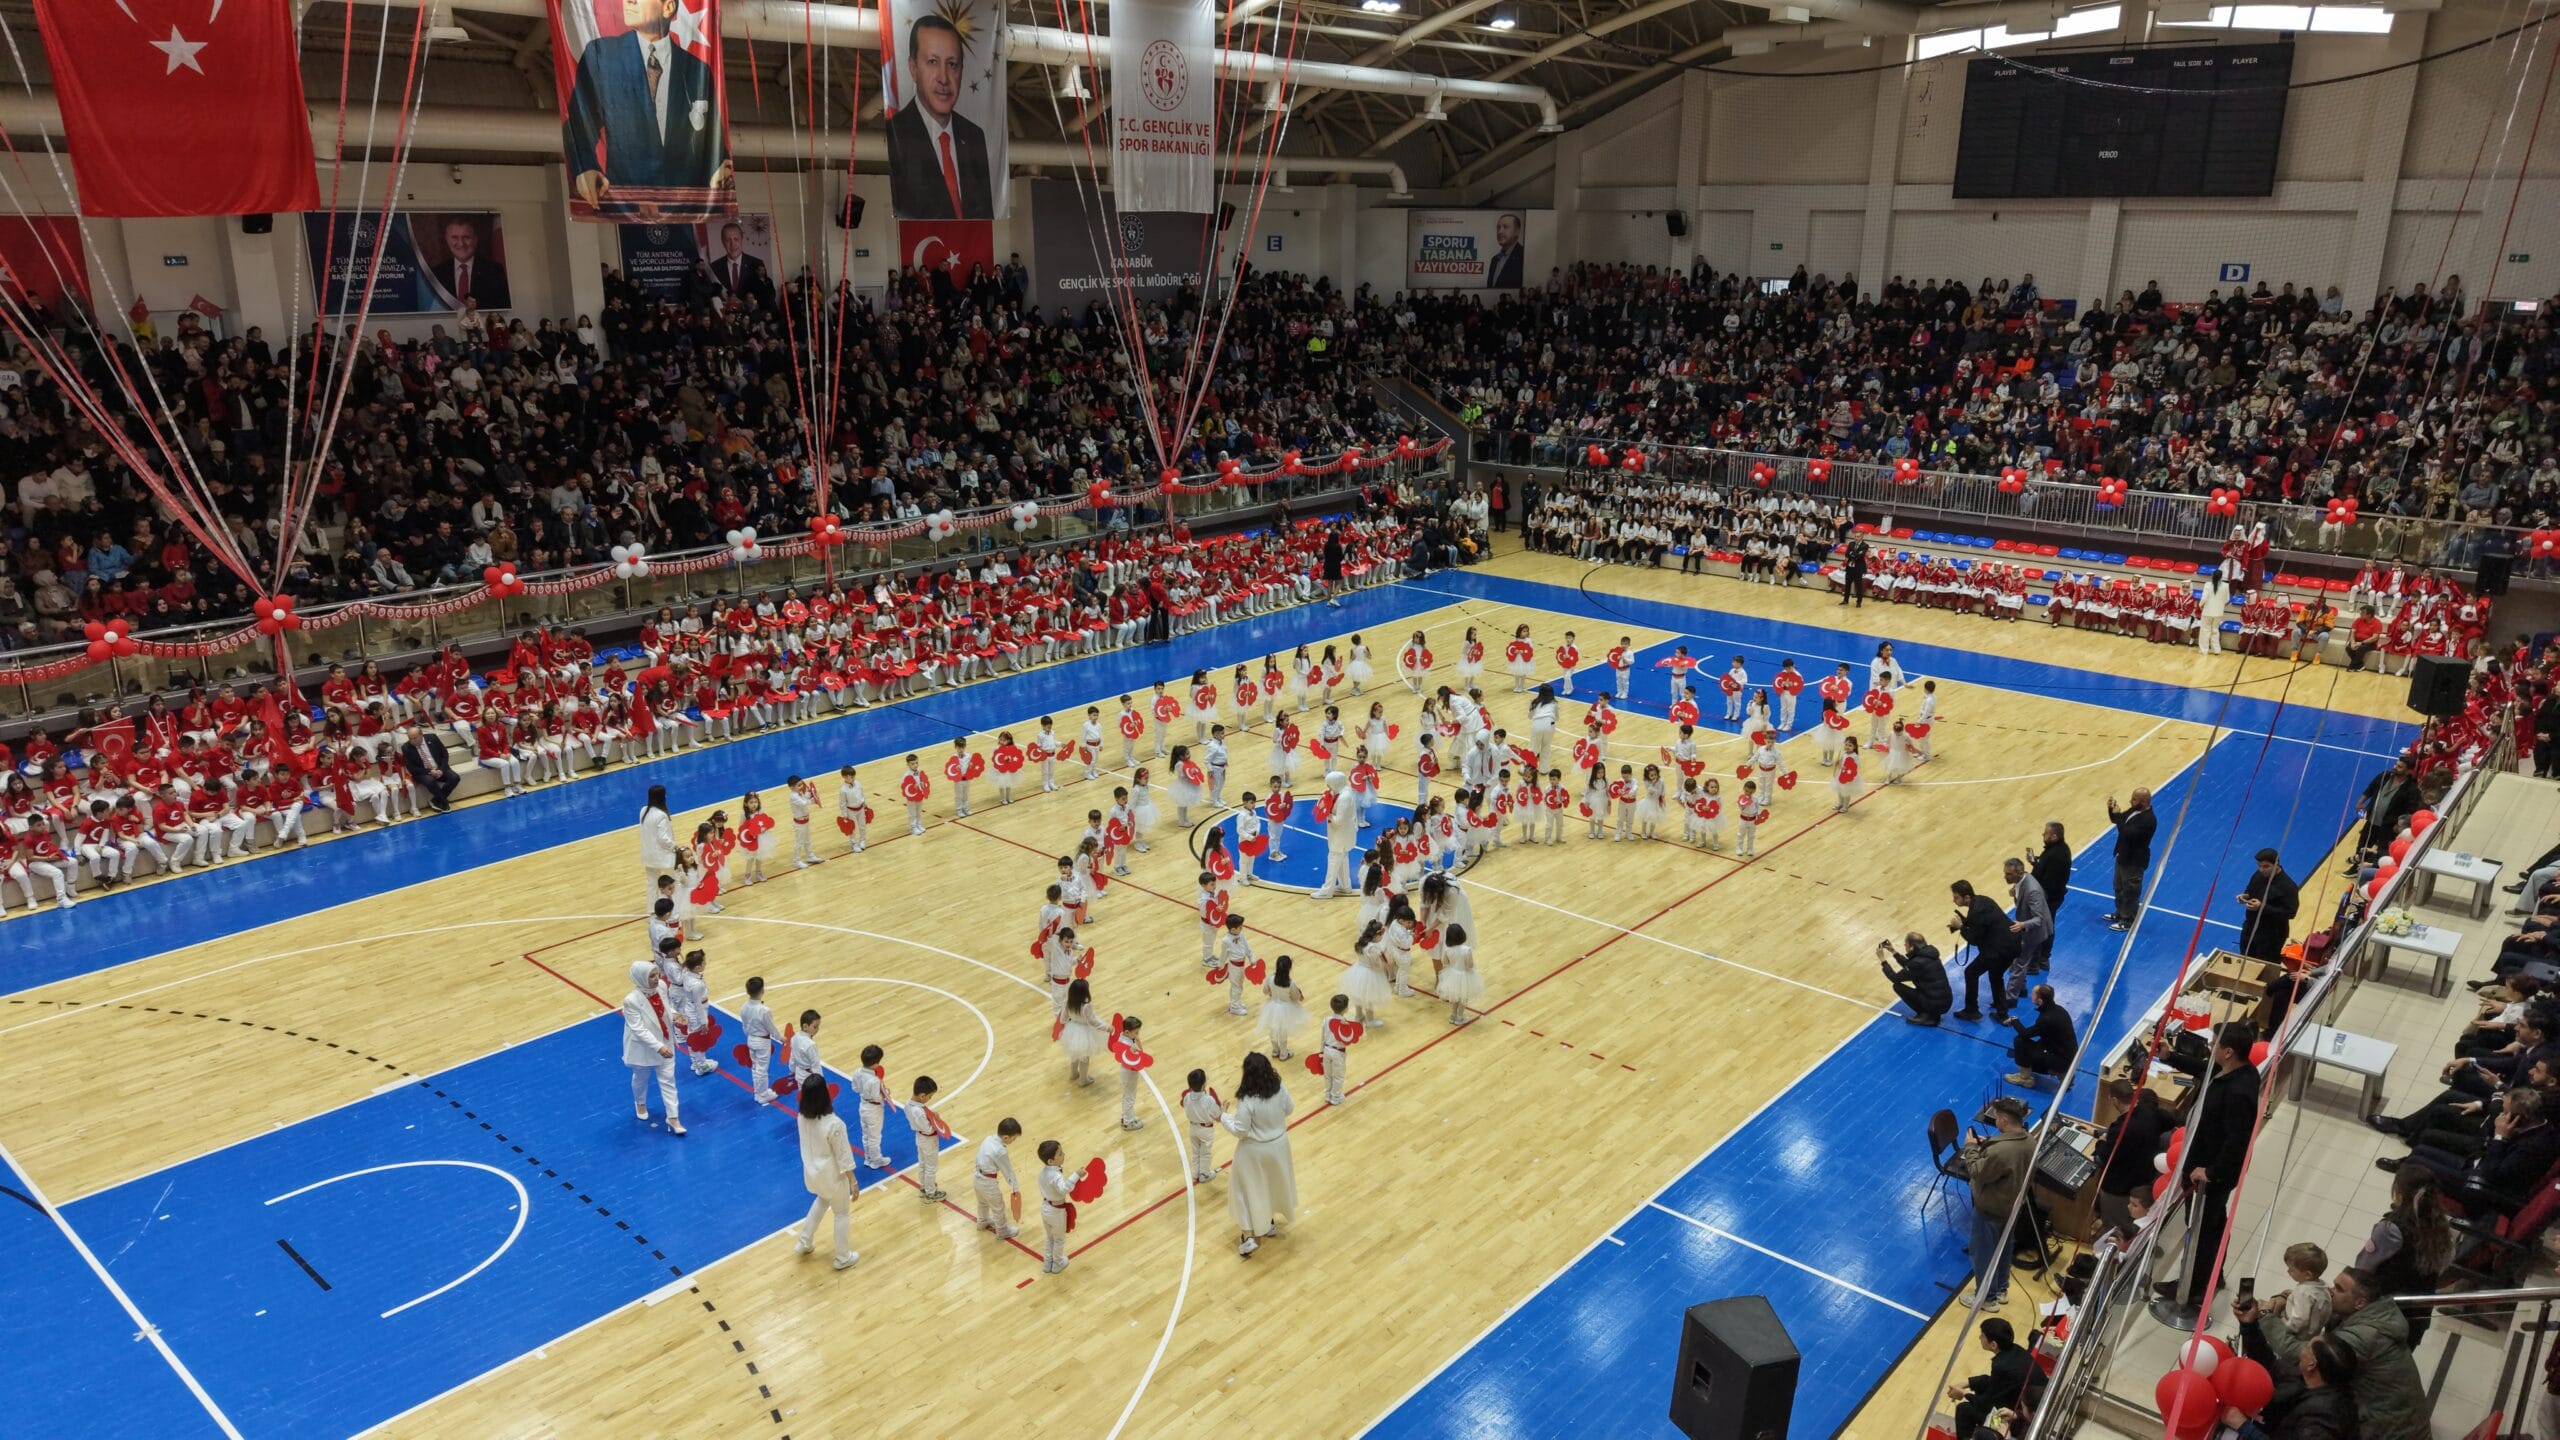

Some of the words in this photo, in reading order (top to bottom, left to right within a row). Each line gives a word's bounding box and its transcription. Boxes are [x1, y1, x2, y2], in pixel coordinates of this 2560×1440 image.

[1118, 118, 1139, 132] T.C.
[1143, 119, 1192, 137] GENÇLİK
[1195, 124, 1210, 137] VE
[1119, 137, 1149, 152] SPOR
[1151, 139, 1210, 156] BAKANLIĞI
[2098, 150, 2119, 159] PERIOD
[1270, 237, 1280, 250] E
[1427, 236, 1468, 248] SPORU
[1423, 249, 1473, 260] TABANA
[1416, 261, 1483, 273] YAYIYORUZ
[2226, 264, 2244, 281] D
[1059, 275, 1098, 292] GENÇLİK
[1098, 277, 1111, 288] VE
[1137, 273, 1145, 288] İL
